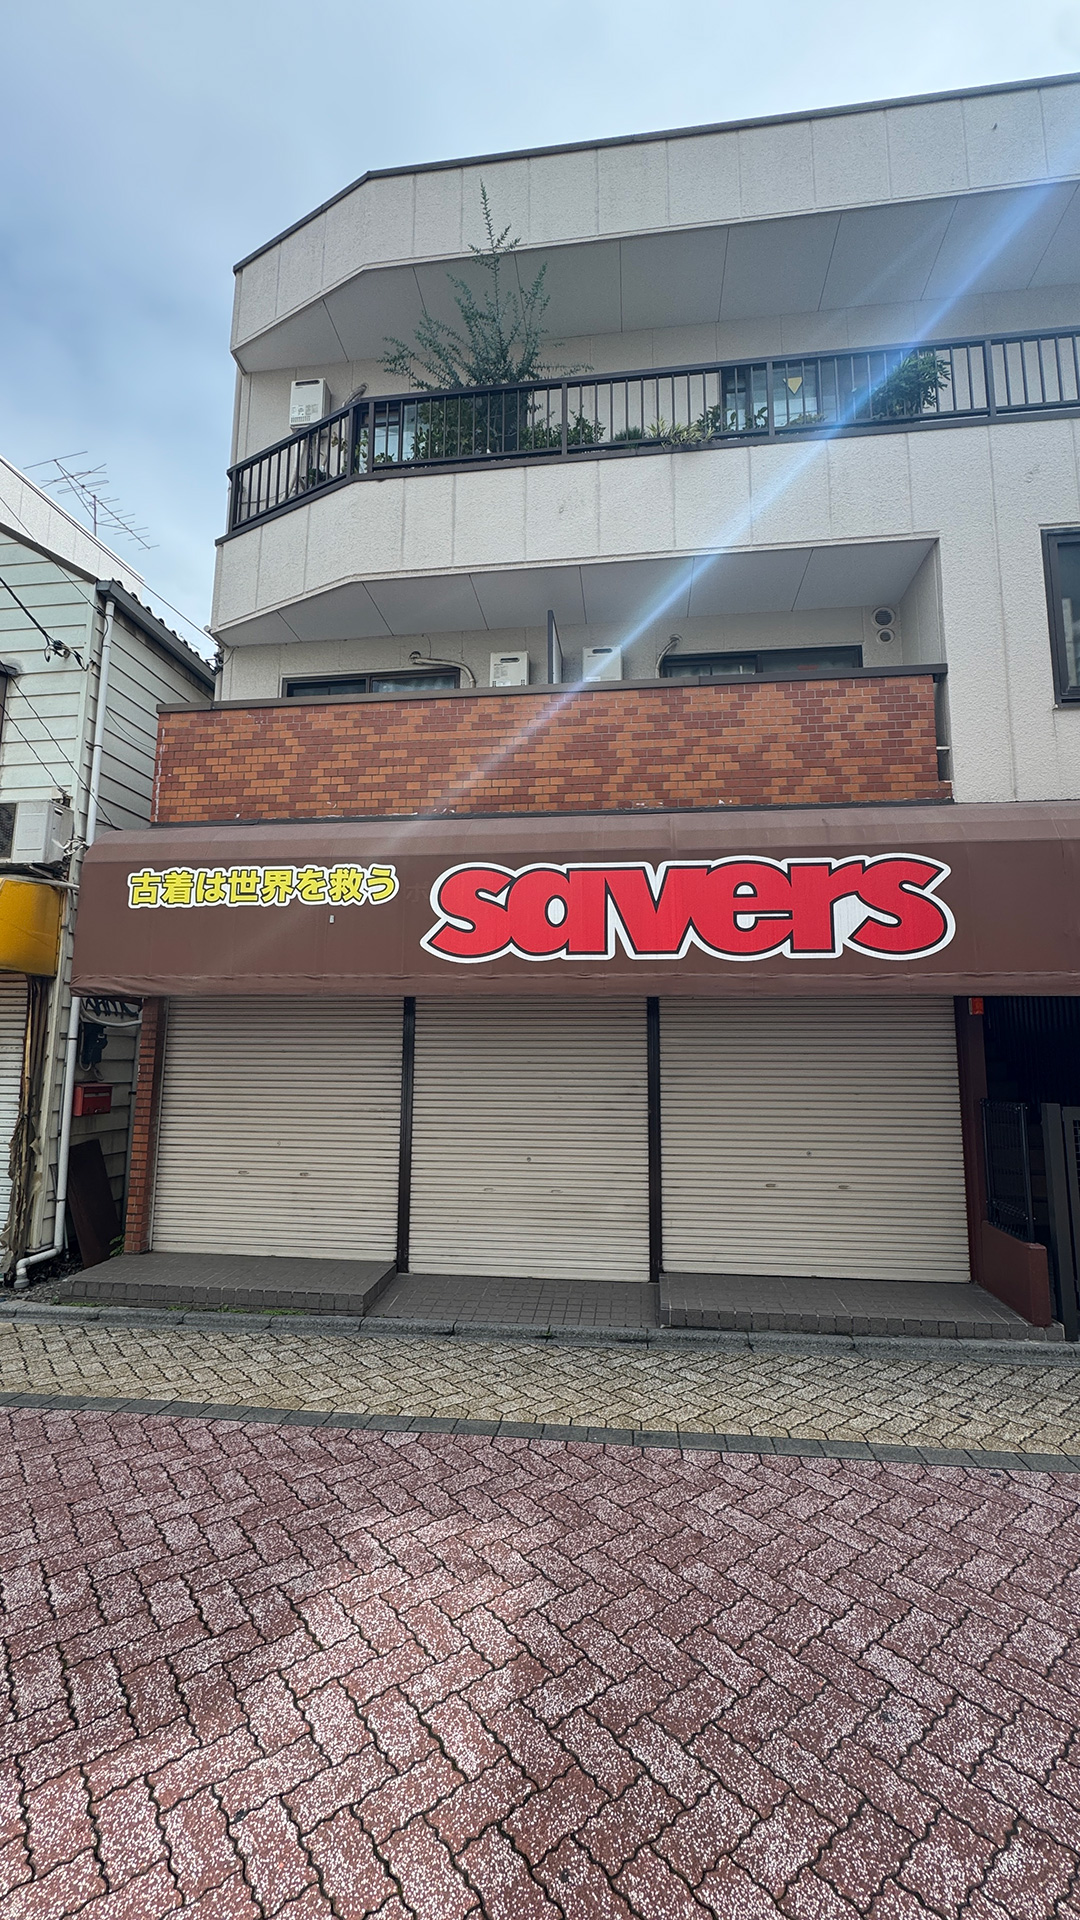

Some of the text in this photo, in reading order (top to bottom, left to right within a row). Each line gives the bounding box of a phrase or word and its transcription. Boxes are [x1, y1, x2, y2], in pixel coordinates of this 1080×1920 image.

[128, 864, 400, 908] 古着は世界を救う
[421, 854, 955, 963] savers
